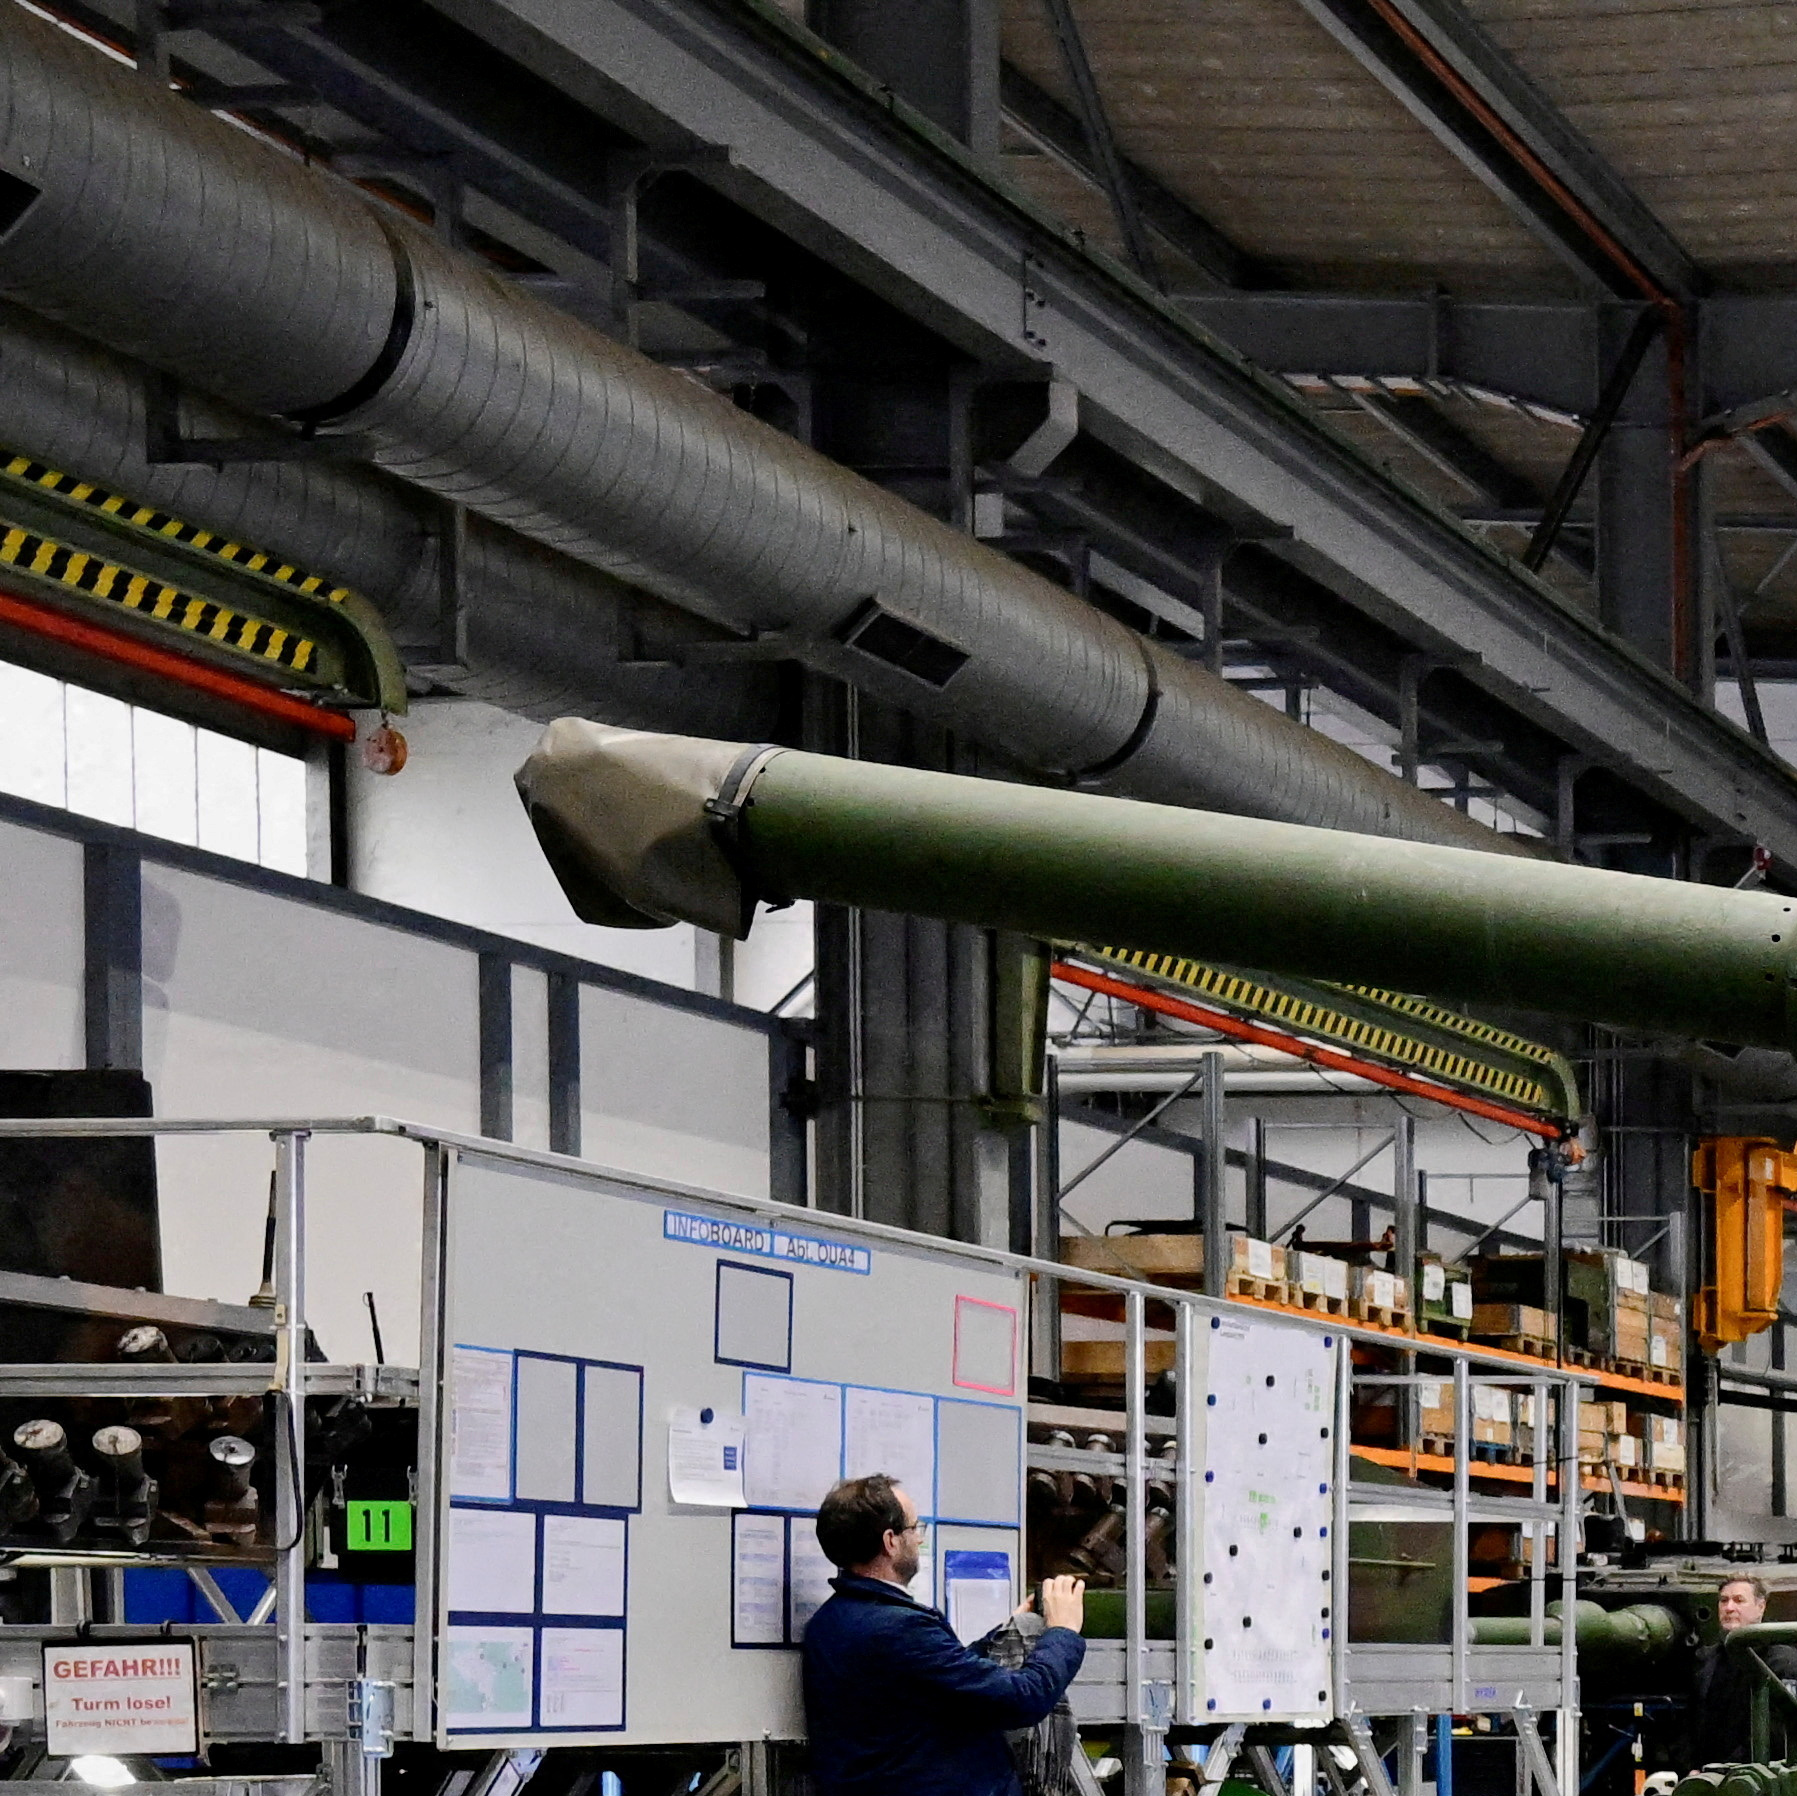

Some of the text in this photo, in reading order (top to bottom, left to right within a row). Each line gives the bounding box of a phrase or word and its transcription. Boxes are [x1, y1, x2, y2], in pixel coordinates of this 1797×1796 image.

[672, 1215, 765, 1251] INFOBOARD
[817, 1245, 855, 1267] OUA4
[362, 1508, 391, 1543] 11
[53, 1658, 180, 1679] GEFAHR!!!
[71, 1695, 171, 1712] Turm lose!
